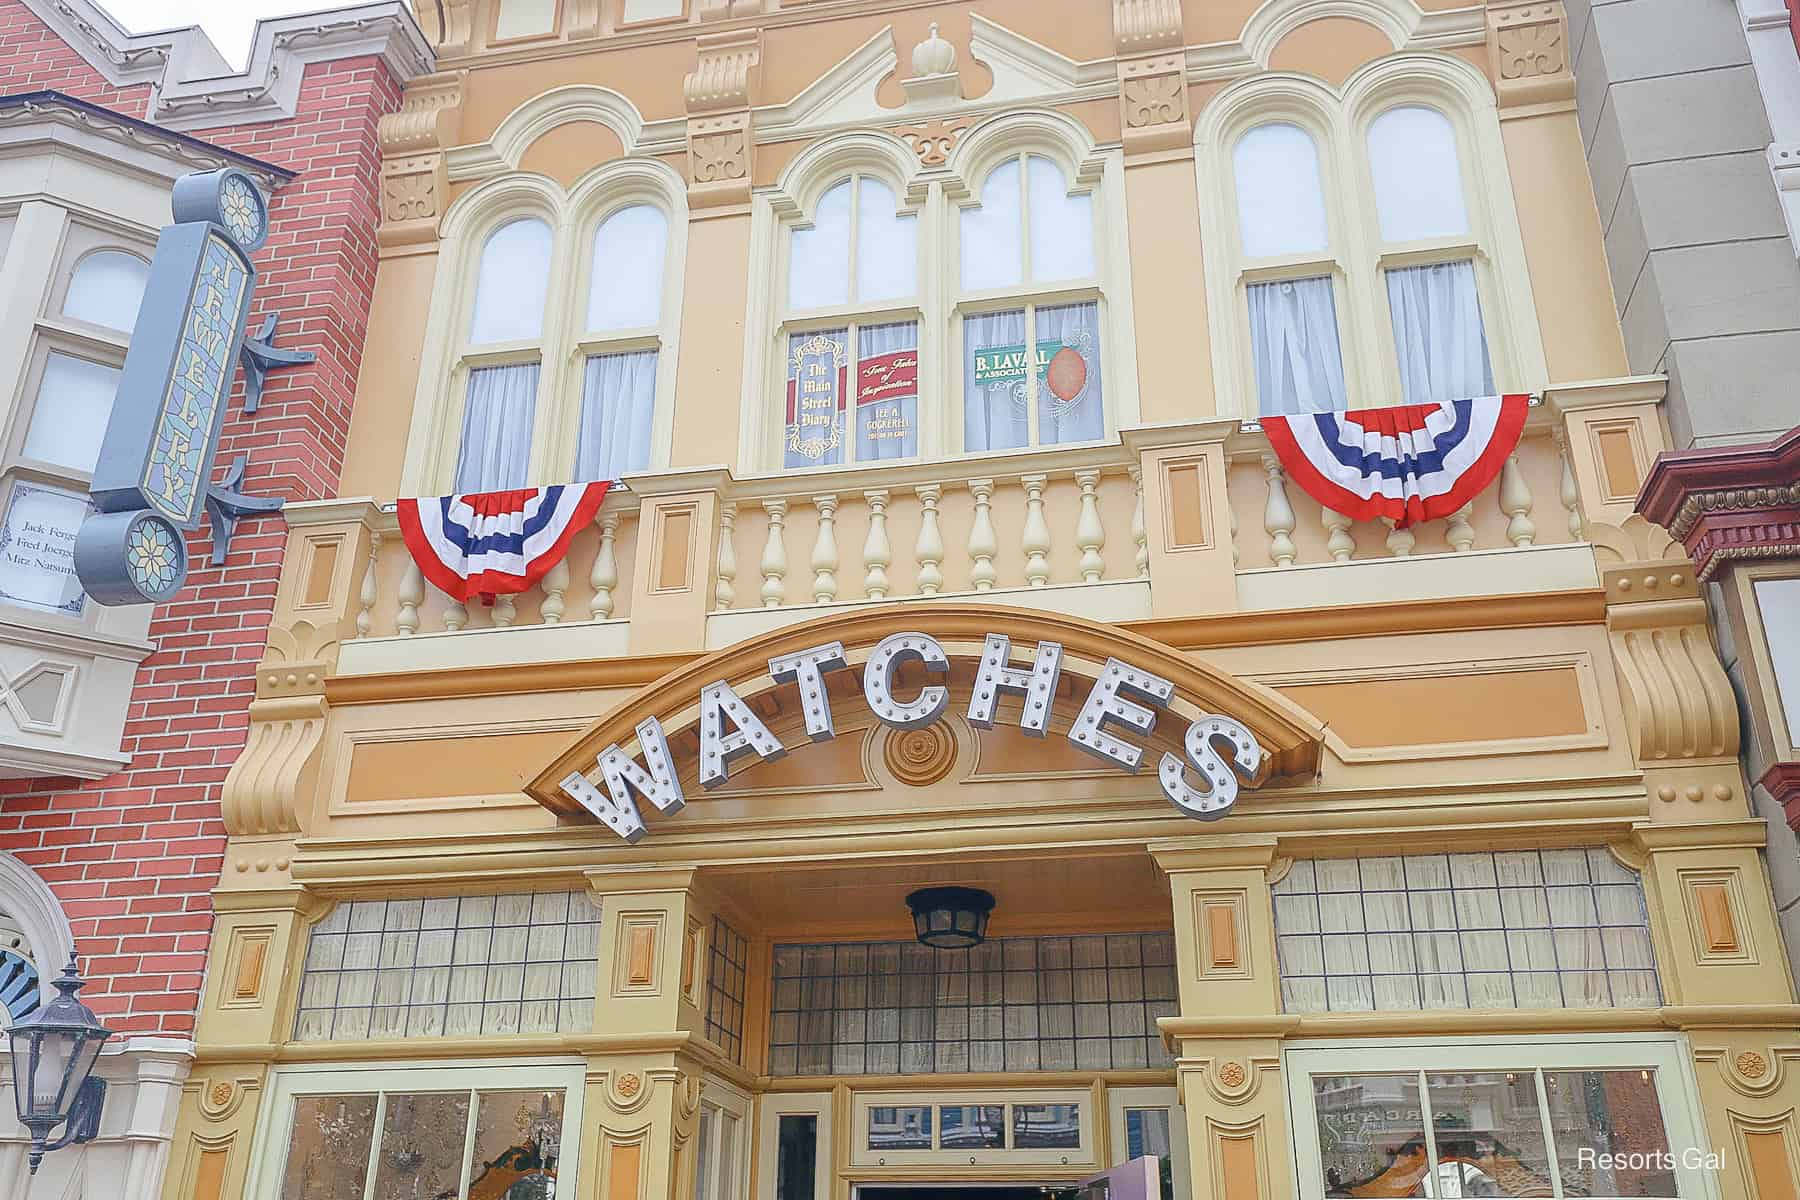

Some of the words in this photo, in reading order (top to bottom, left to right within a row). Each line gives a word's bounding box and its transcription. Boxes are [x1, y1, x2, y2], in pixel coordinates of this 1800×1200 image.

[808, 363, 827, 377] The
[975, 357, 990, 371] B.
[163, 255, 233, 502] JEWELRY
[984, 366, 1044, 378] ASSOCIATS
[803, 380, 831, 393] Main
[801, 396, 833, 410] Street
[800, 413, 831, 427] Diary
[21, 521, 45, 534] Jack
[50, 527, 77, 542] Ferge
[16, 537, 40, 550] Fred
[42, 543, 74, 558] Joerge
[7, 552, 31, 566] Mitz
[34, 558, 76, 575] Natsum
[558, 631, 1264, 844] WATCHES
